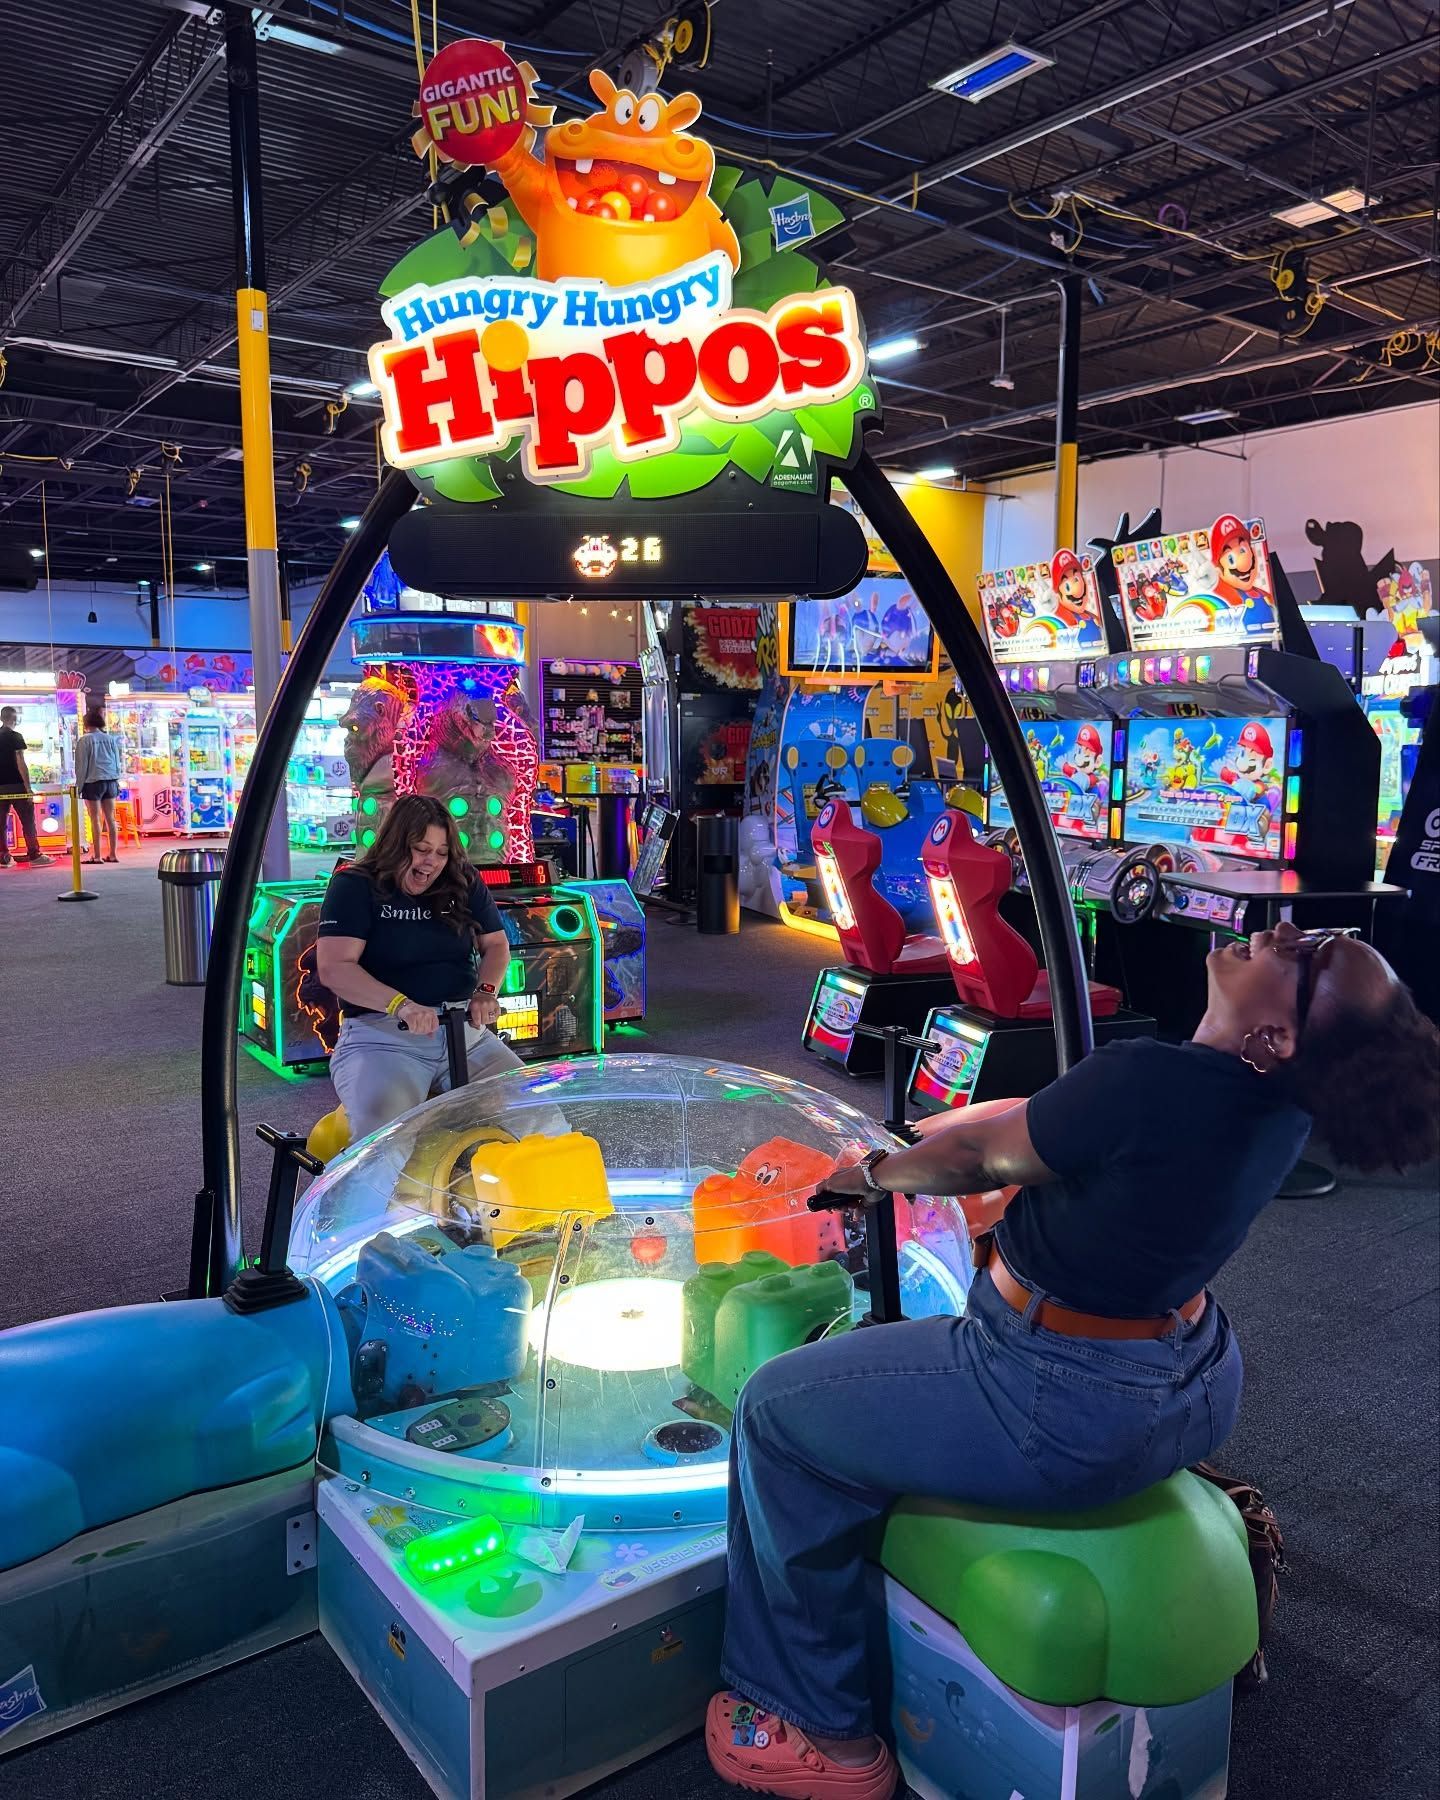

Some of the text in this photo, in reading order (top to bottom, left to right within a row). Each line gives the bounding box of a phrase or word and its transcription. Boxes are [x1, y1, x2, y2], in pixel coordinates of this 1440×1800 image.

[423, 66, 514, 103] GIGANTIC
[427, 86, 520, 140] FUN!
[771, 211, 812, 226] Hasbro
[393, 265, 720, 342] Hungry Hungry
[383, 299, 852, 470] Hippos
[620, 537, 661, 562] 26
[381, 905, 431, 920] Smile
[693, 1533, 728, 1553] POTA
[641, 1547, 692, 1574] VEGGIE
[0, 1686, 39, 1709] asbro
